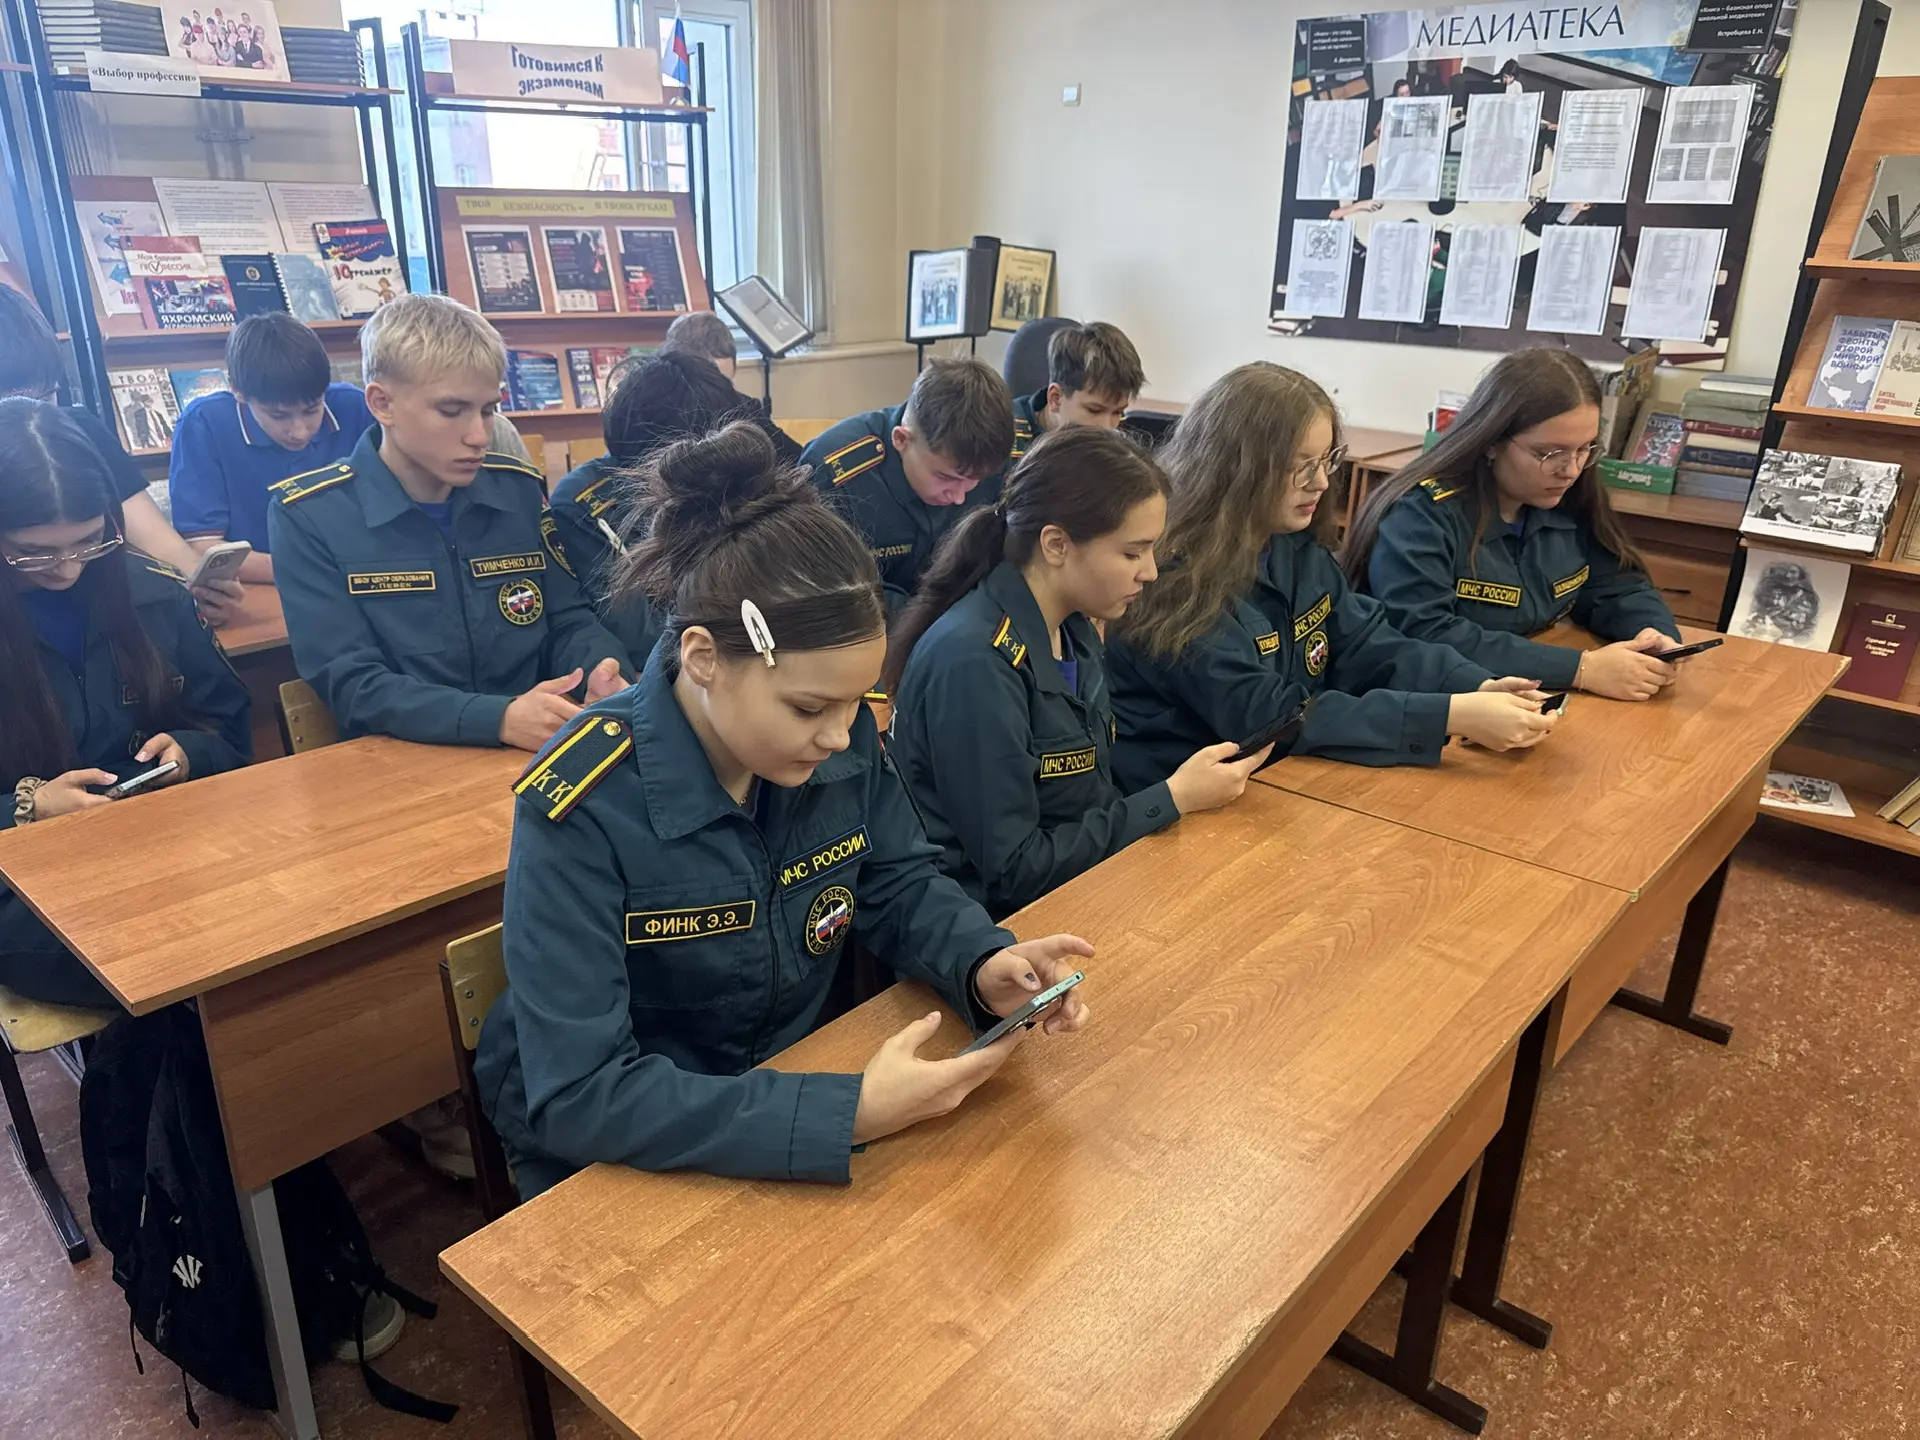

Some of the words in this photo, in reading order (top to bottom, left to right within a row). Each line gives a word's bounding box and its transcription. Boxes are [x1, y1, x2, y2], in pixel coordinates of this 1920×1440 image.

[1416, 4, 1625, 48] МЕДИАТЕКА
[511, 45, 593, 73] Готовимся
[92, 66, 133, 79] «Выбор
[137, 70, 197, 83] профессии»
[518, 77, 604, 100] экзаменам
[503, 201, 576, 212] БЕЗОПАСНОСТЬ
[161, 312, 235, 324] ЯХРОМСКИЙ
[1838, 337, 1879, 347] ФРОНТЫ
[1840, 329, 1887, 339] ЗАБЫТЫЕ
[1835, 345, 1873, 354] ВТОРОЙ
[1830, 361, 1865, 371] ВОЙНЫ
[1833, 353, 1881, 364] МИРОВОЙ
[118, 373, 157, 384] ТВОЯ
[476, 558, 525, 573] ТИМЧЕНКО
[1460, 583, 1481, 596] МЧС
[1482, 586, 1517, 602] РОССИИ
[1043, 758, 1064, 773] МЧС
[1066, 752, 1093, 770] РОССИИ
[812, 833, 866, 871] РОССИИ
[645, 915, 702, 936] ФИНК
[707, 910, 739, 929] Э.Э.
[809, 904, 822, 929] МЧС
